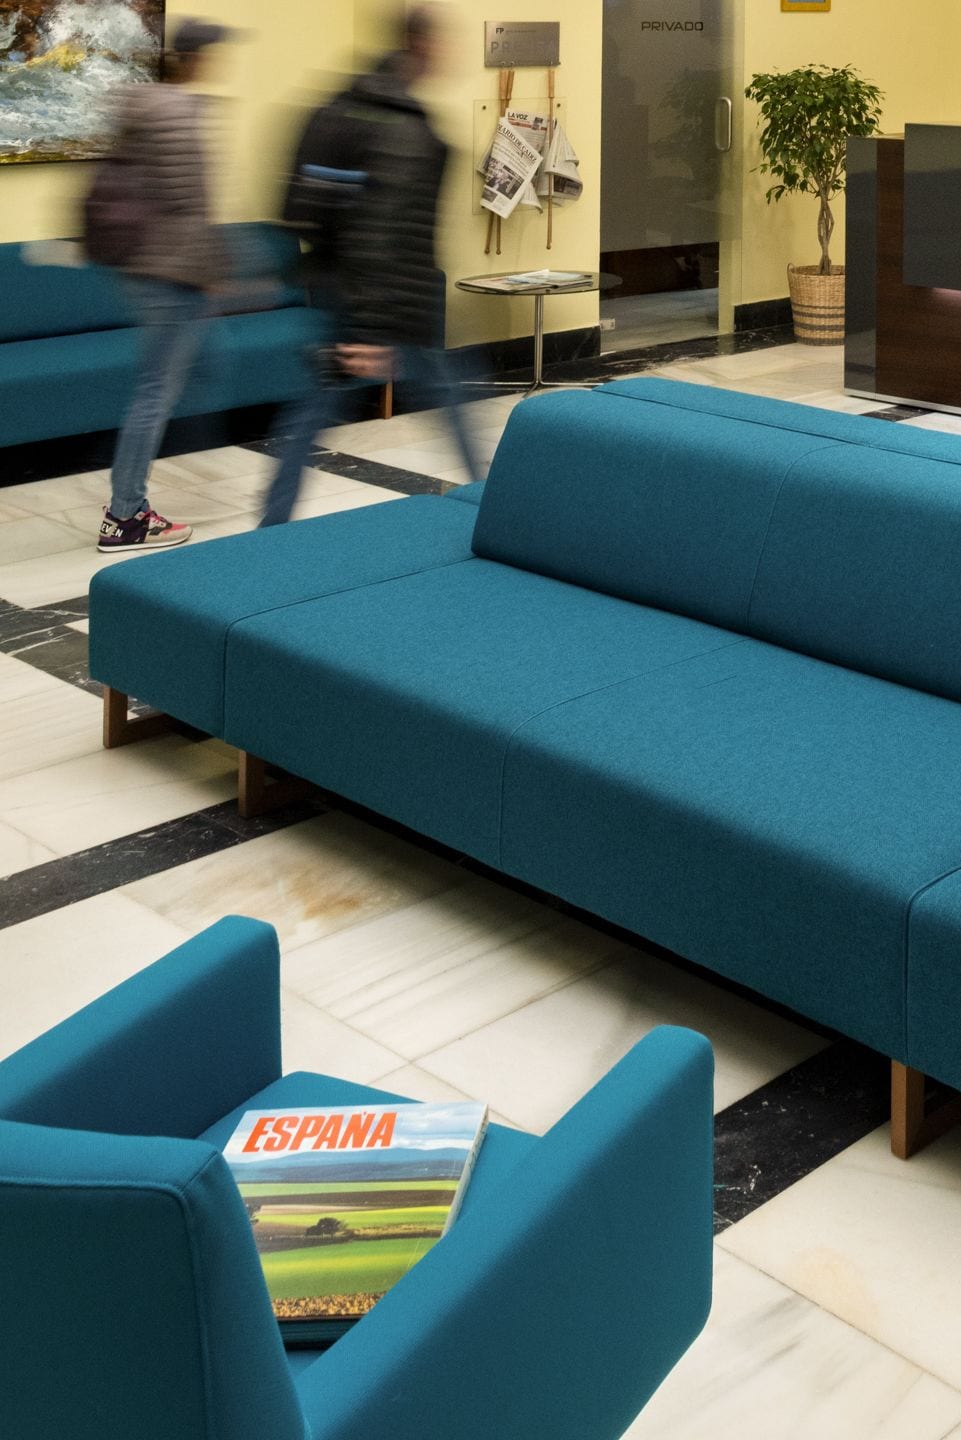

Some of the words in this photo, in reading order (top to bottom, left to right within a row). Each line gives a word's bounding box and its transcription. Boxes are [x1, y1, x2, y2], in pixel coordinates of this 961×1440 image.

[640, 21, 704, 32] PRIVADO
[516, 113, 529, 121] VOZ
[241, 1110, 398, 1153] ESPAÑA
